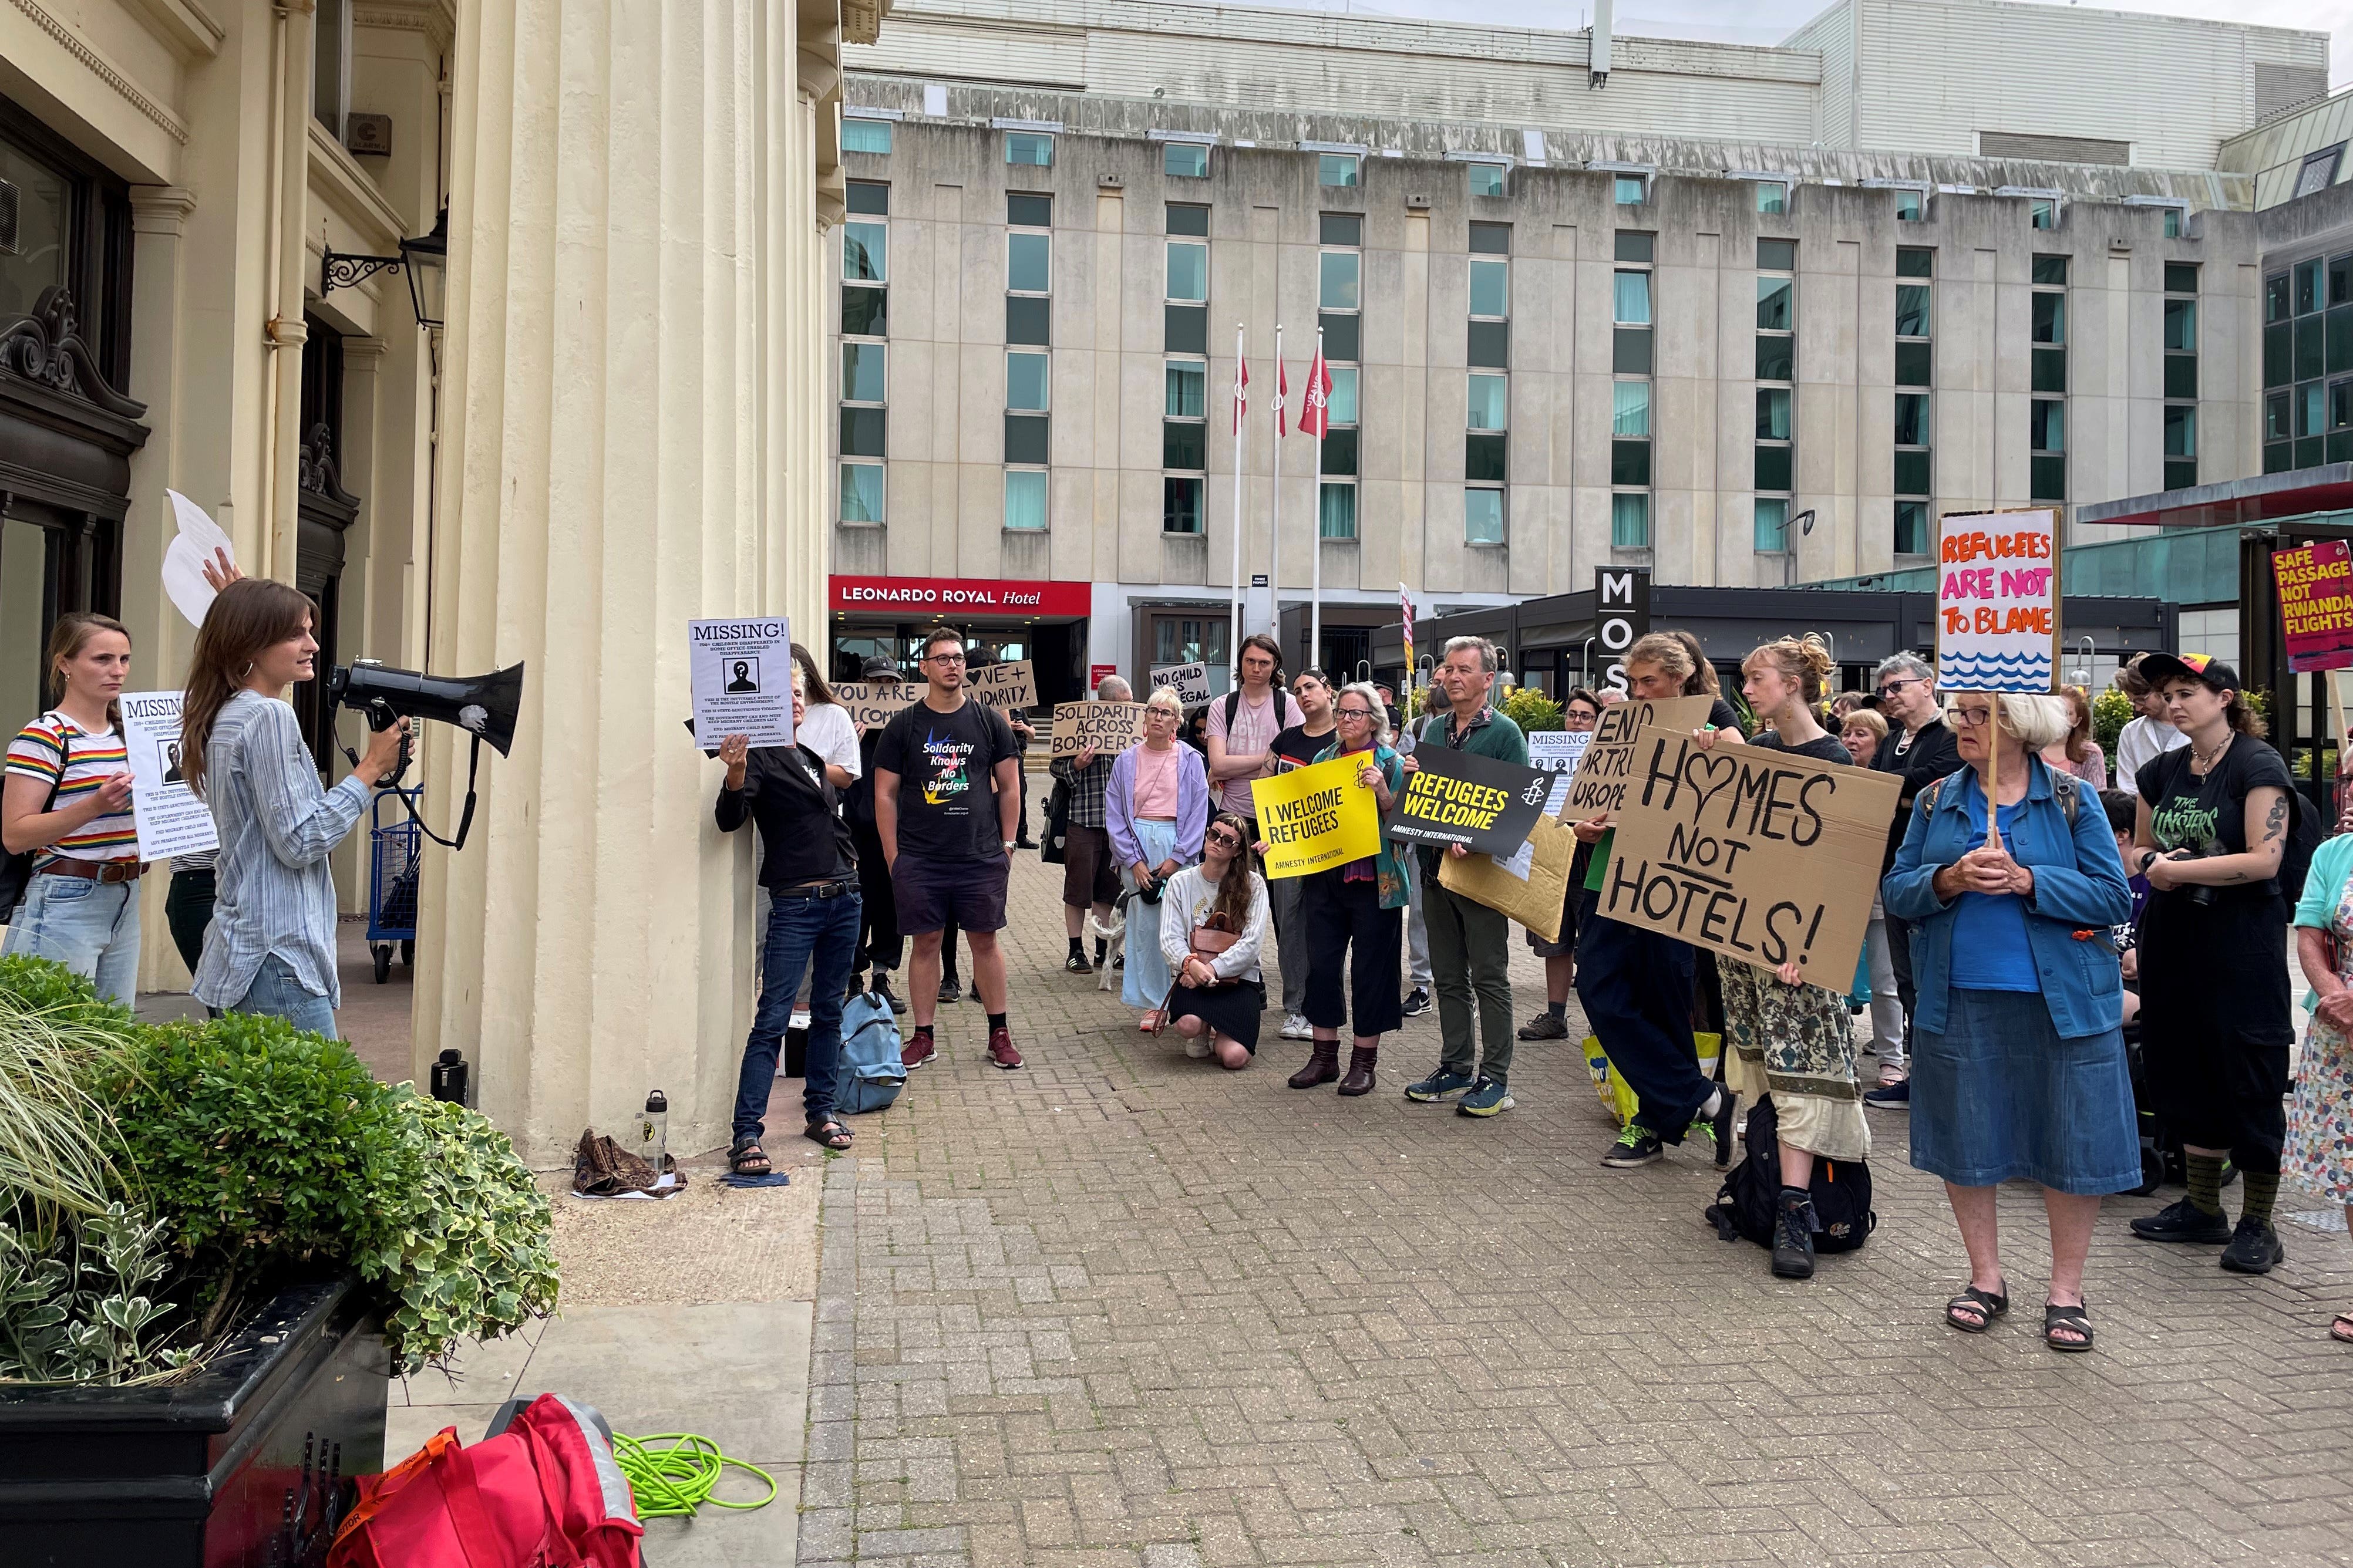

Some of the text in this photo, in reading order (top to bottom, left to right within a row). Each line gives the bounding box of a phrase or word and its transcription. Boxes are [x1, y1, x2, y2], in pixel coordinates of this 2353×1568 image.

[1942, 531, 2051, 564] REFUGEES
[2274, 549, 2314, 570] SAFE
[1941, 567, 2052, 599] ARE NOT
[2277, 560, 2351, 586] PASSAGE
[843, 587, 1041, 605] LEONARDO ROYAL Hotel
[2280, 583, 2311, 602] NOT
[2283, 594, 2353, 619] RWANDA
[1975, 606, 2052, 635] BLAME
[2285, 611, 2353, 635] FLIGHTS
[694, 623, 785, 640] MISSING!
[1153, 667, 1202, 686] NO CHILD
[828, 683, 915, 701] YOU ARE
[126, 699, 181, 718] MISSIN
[1055, 705, 1147, 723] SOLIDARIT
[1075, 719, 1133, 734] ACROSS
[922, 743, 974, 755] Solidarity
[930, 756, 966, 766] Knows
[941, 768, 956, 778] No
[928, 780, 970, 791] Borders
[1409, 771, 1509, 811] REFUGEES
[1573, 781, 1627, 811] UROPE
[1265, 787, 1344, 824] I WELCOME
[1403, 793, 1498, 830] WELCOME
[2174, 795, 2199, 810] THE
[1268, 810, 1339, 844] REFUGEES
[1391, 824, 1474, 844] AMNESTY INTERNATIONAL
[1275, 847, 1344, 869] AMNESTY INTERNATIONAL
[1667, 822, 1751, 874] NOT
[1608, 857, 1825, 965] HOTELS!
